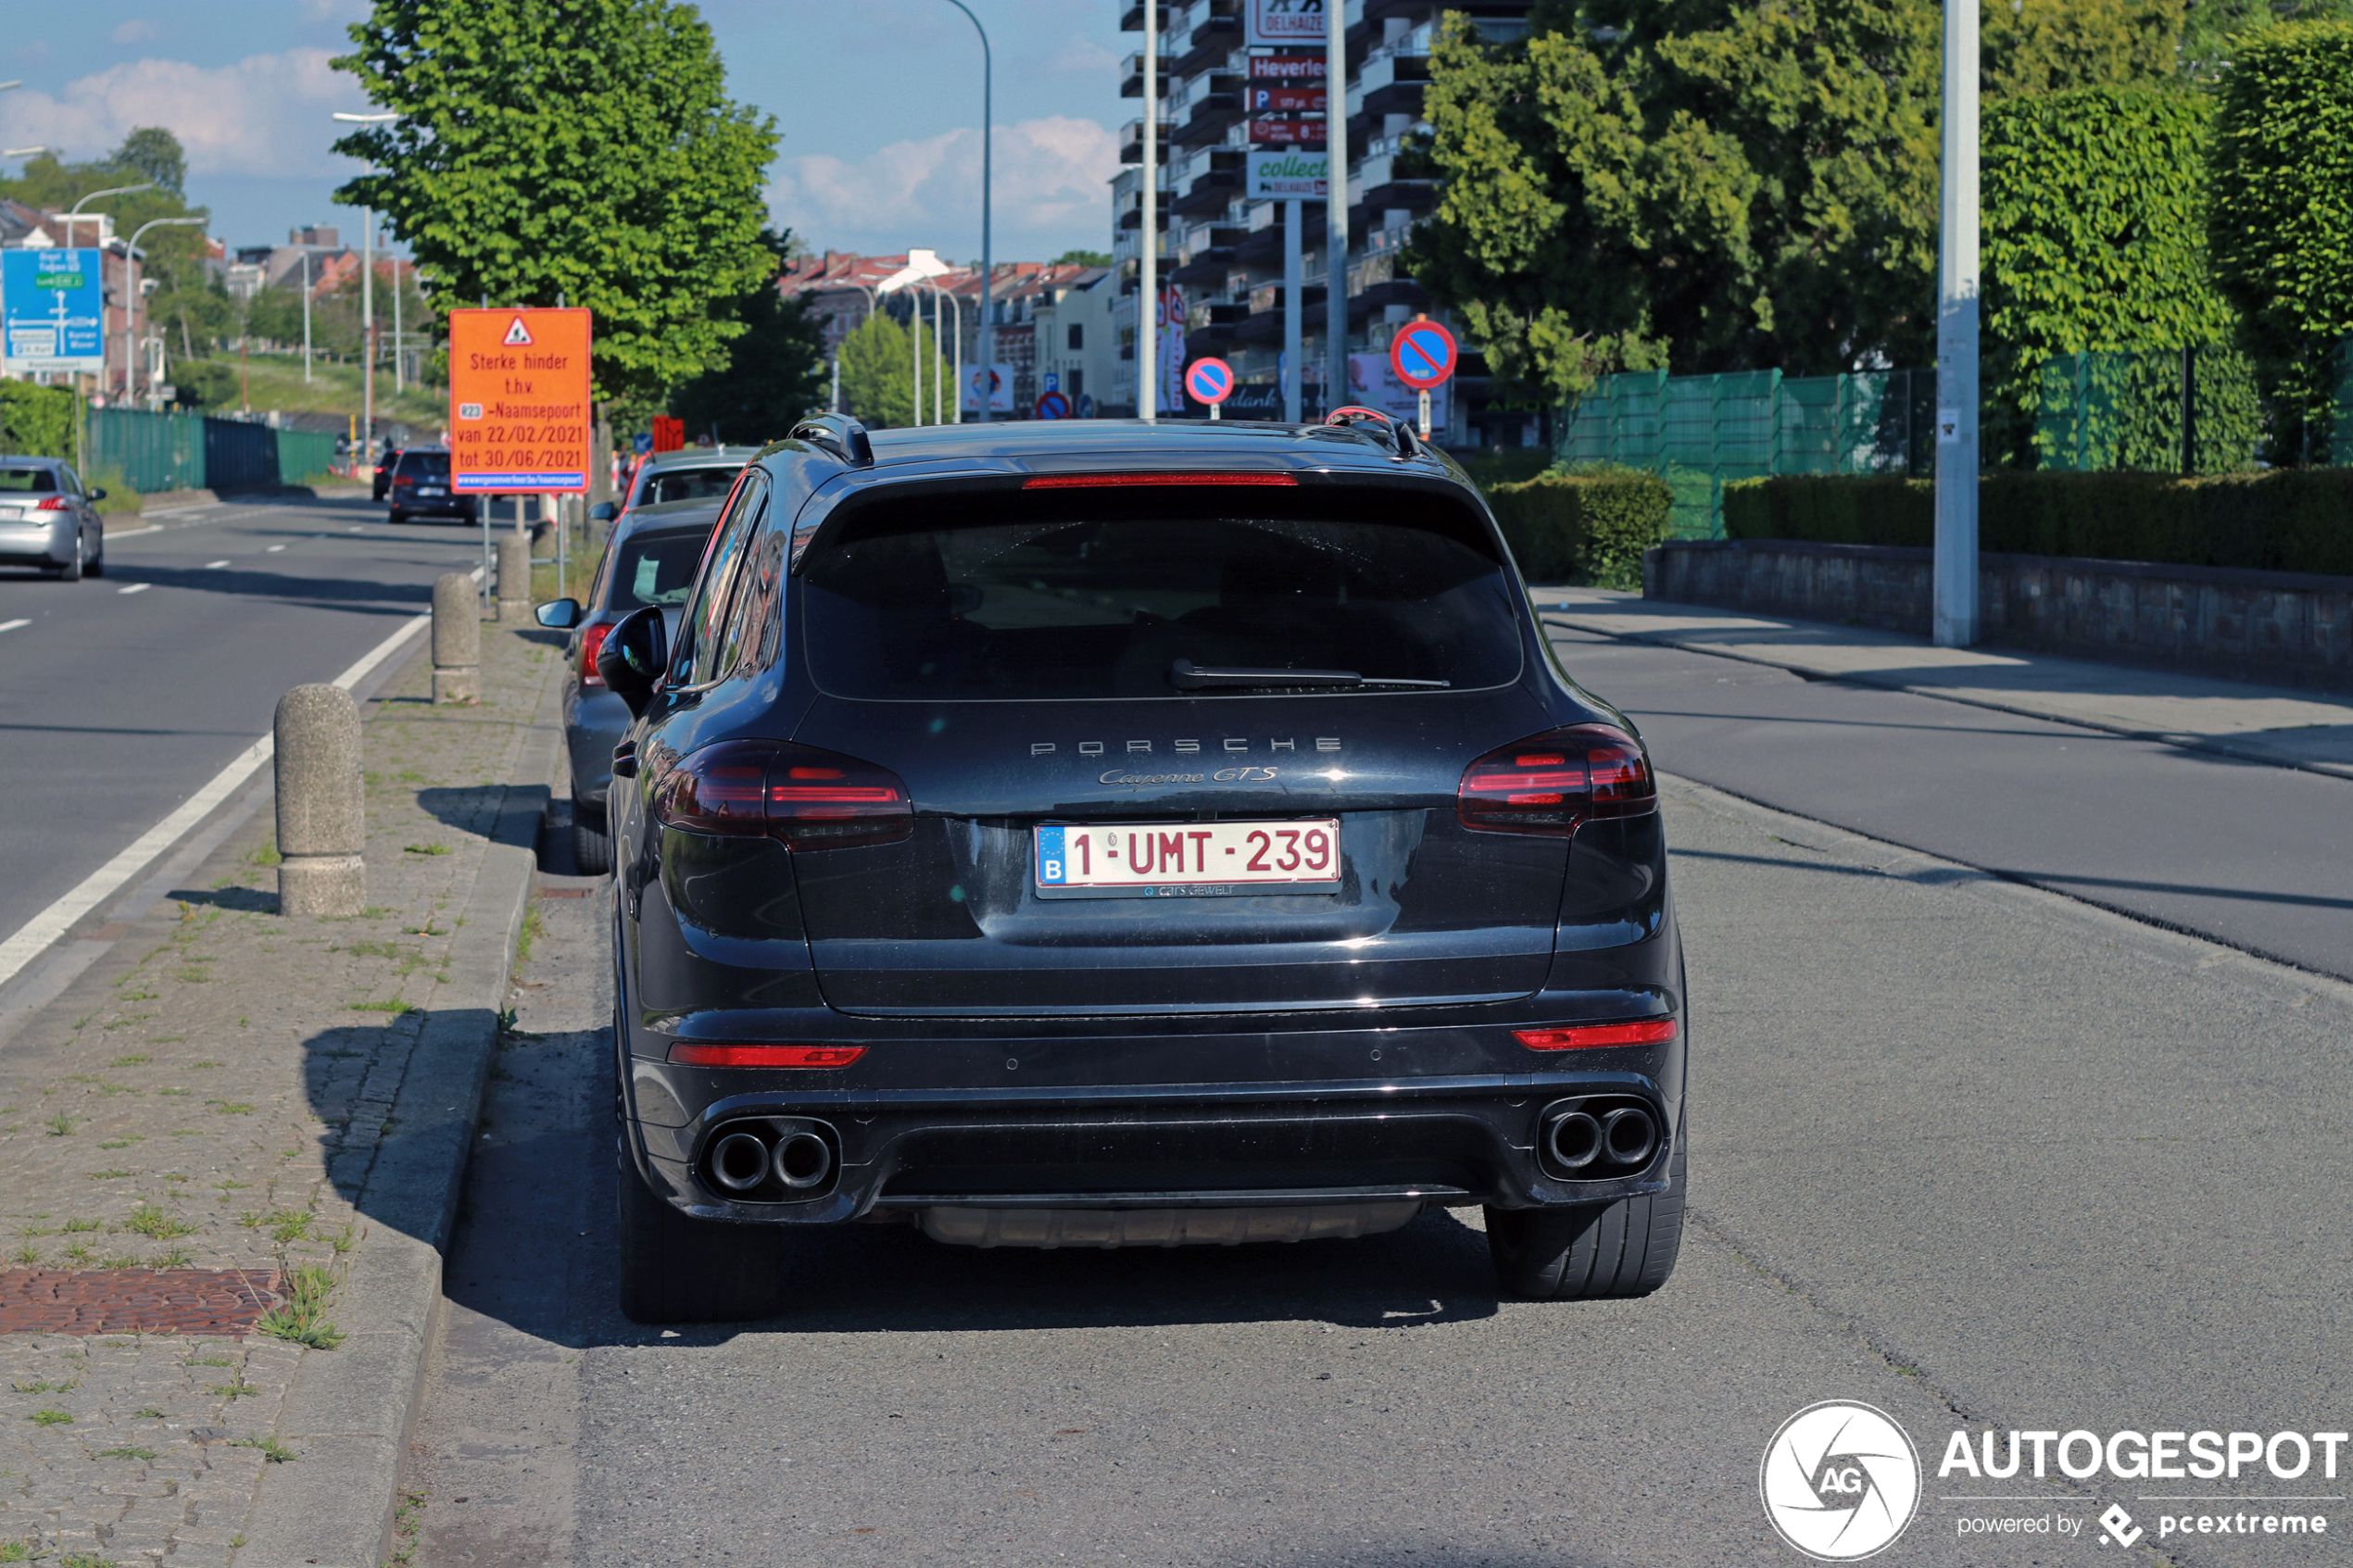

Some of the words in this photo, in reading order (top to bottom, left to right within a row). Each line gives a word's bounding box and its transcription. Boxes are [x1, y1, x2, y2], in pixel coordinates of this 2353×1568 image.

[1265, 16, 1323, 31] DELHAIZE
[1254, 58, 1327, 77] Heverle
[1258, 156, 1327, 178] collect
[1273, 182, 1312, 193] DELHAIZE
[471, 353, 516, 370] Sterke
[524, 353, 568, 370] hinder
[506, 378, 534, 394] t.h.v.
[458, 430, 481, 443] van
[487, 425, 583, 444] 22/02/2021
[459, 452, 478, 467] tot
[484, 450, 581, 468] 30/06/2021
[1030, 737, 1341, 756] PORSCHE
[1099, 770, 1203, 792] Cayenne
[1212, 766, 1278, 783] GTS
[1075, 829, 1330, 875] 1-UMT-239
[1045, 860, 1062, 879] B
